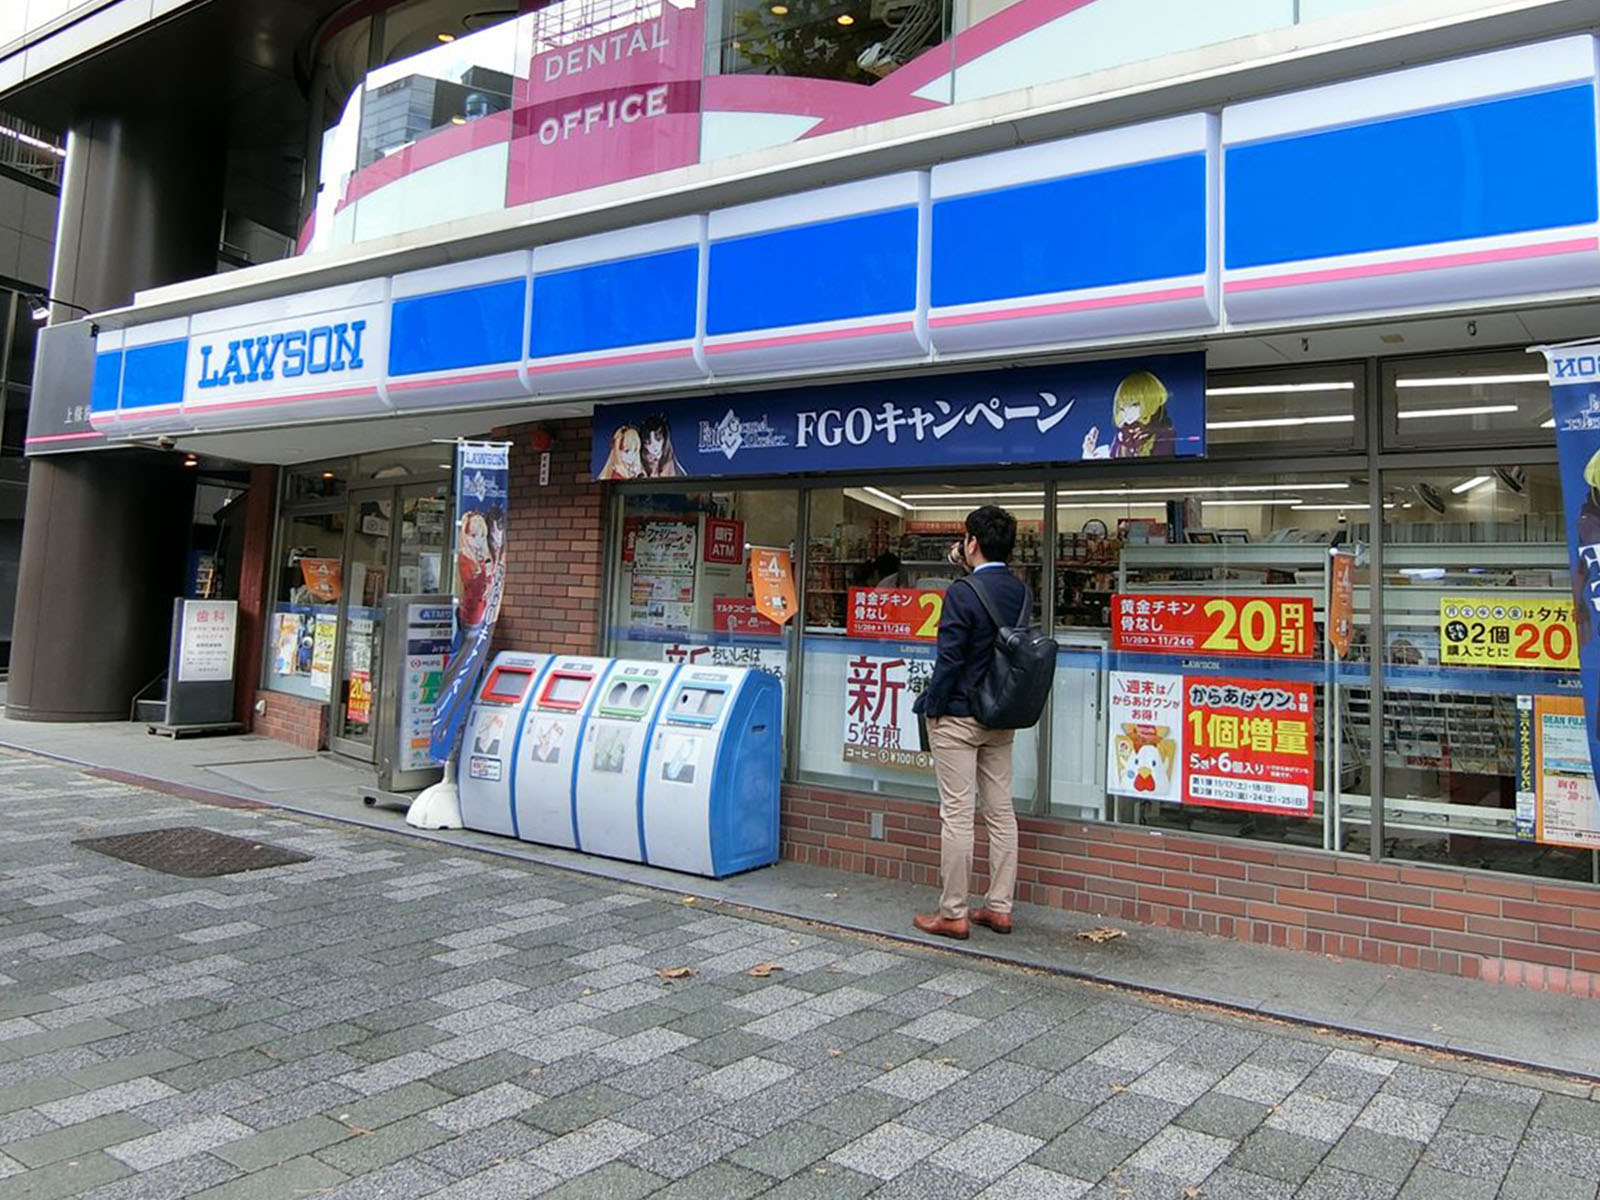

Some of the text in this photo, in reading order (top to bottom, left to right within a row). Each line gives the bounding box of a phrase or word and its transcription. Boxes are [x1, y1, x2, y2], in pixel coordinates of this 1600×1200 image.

[543, 24, 670, 82] DENTAL
[538, 84, 669, 146] OFFICE
[198, 320, 366, 389] LAWSON
[795, 391, 1076, 448] FGOキャンペーン
[711, 545, 735, 558] ATM
[855, 592, 912, 606] 黄金チキン
[855, 606, 888, 621] 骨なし
[915, 592, 943, 637] 2
[1120, 599, 1196, 616] 黄金チキン
[1120, 616, 1163, 632] 骨なし
[1201, 599, 1277, 653] 20
[1514, 623, 1573, 661] 20
[1446, 644, 1510, 658] 購入ごとに
[847, 655, 906, 731] 新
[1126, 680, 1166, 695] 週末は
[1188, 710, 1309, 755] 1個増量
